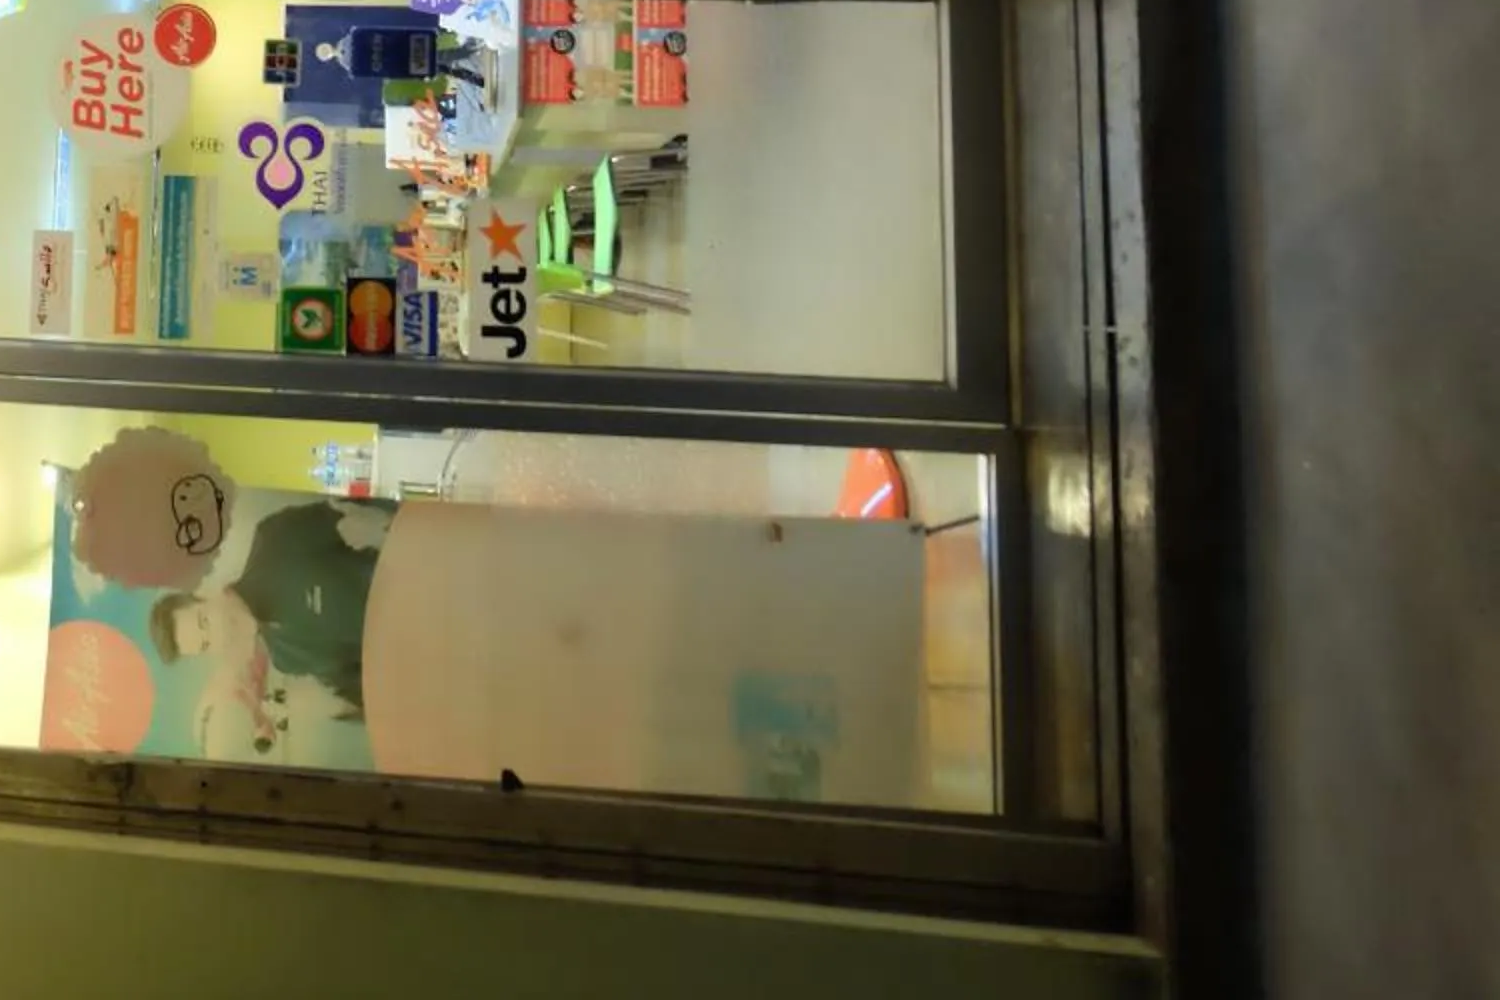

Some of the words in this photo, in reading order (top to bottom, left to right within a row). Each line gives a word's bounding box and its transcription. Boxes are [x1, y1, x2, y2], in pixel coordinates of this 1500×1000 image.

[72, 39, 114, 132] Buy
[109, 27, 145, 140] Here
[310, 170, 329, 216] THAI
[403, 291, 423, 347] VISA
[480, 265, 528, 359] Jet
